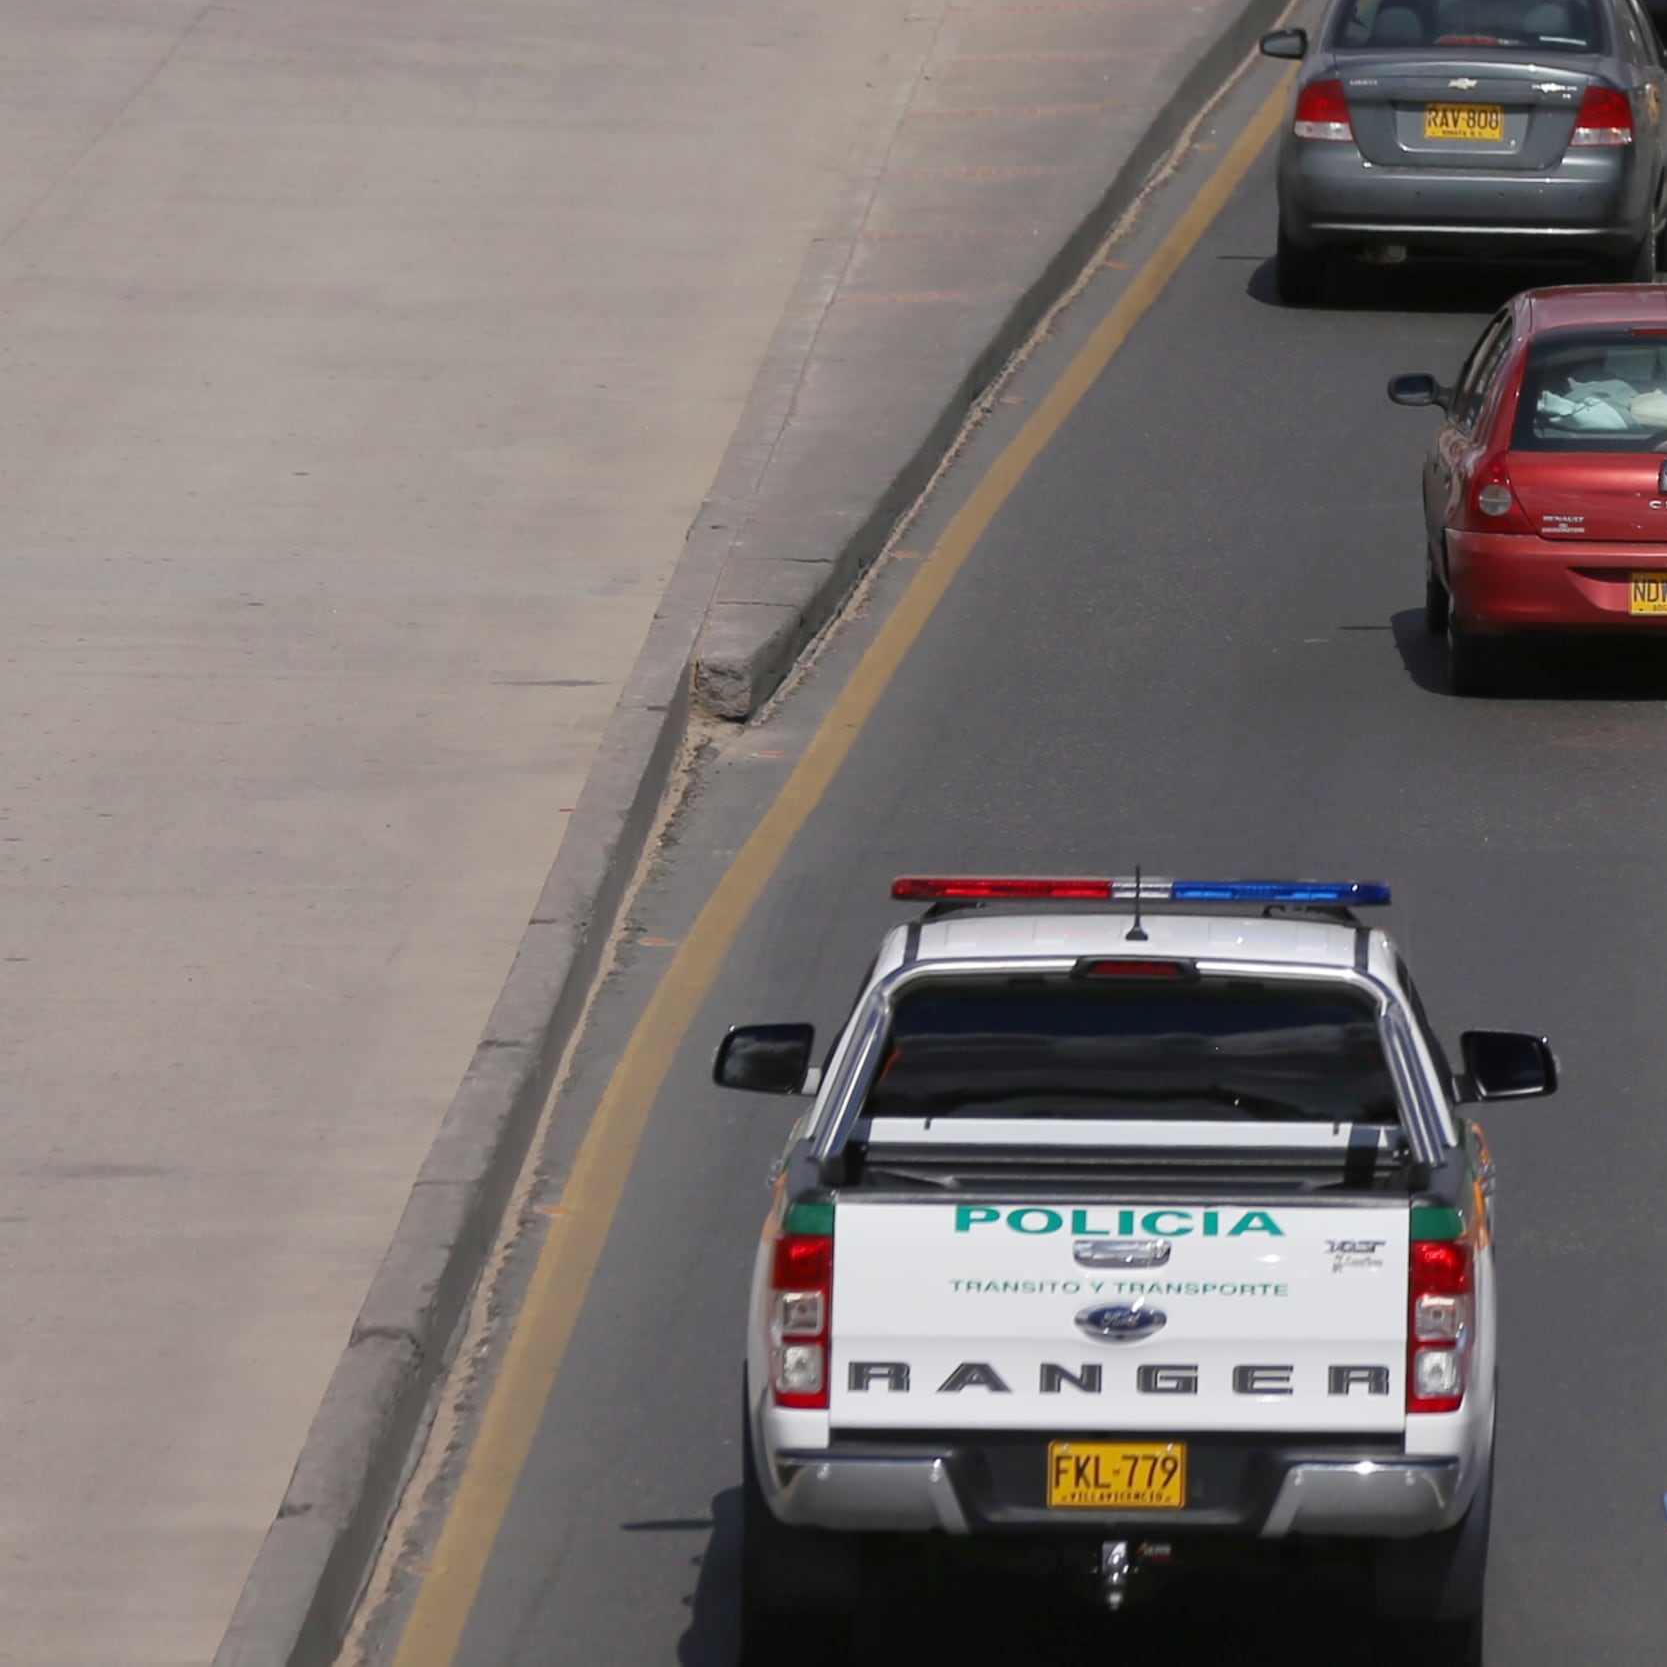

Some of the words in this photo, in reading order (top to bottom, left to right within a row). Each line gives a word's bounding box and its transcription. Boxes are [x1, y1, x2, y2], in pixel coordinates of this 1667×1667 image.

[949, 1279, 1081, 1295] TRANSITO
[1090, 1282, 1107, 1295] Y
[1112, 1281, 1289, 1297] TRANSPORTE
[847, 1361, 1390, 1396] RANGER
